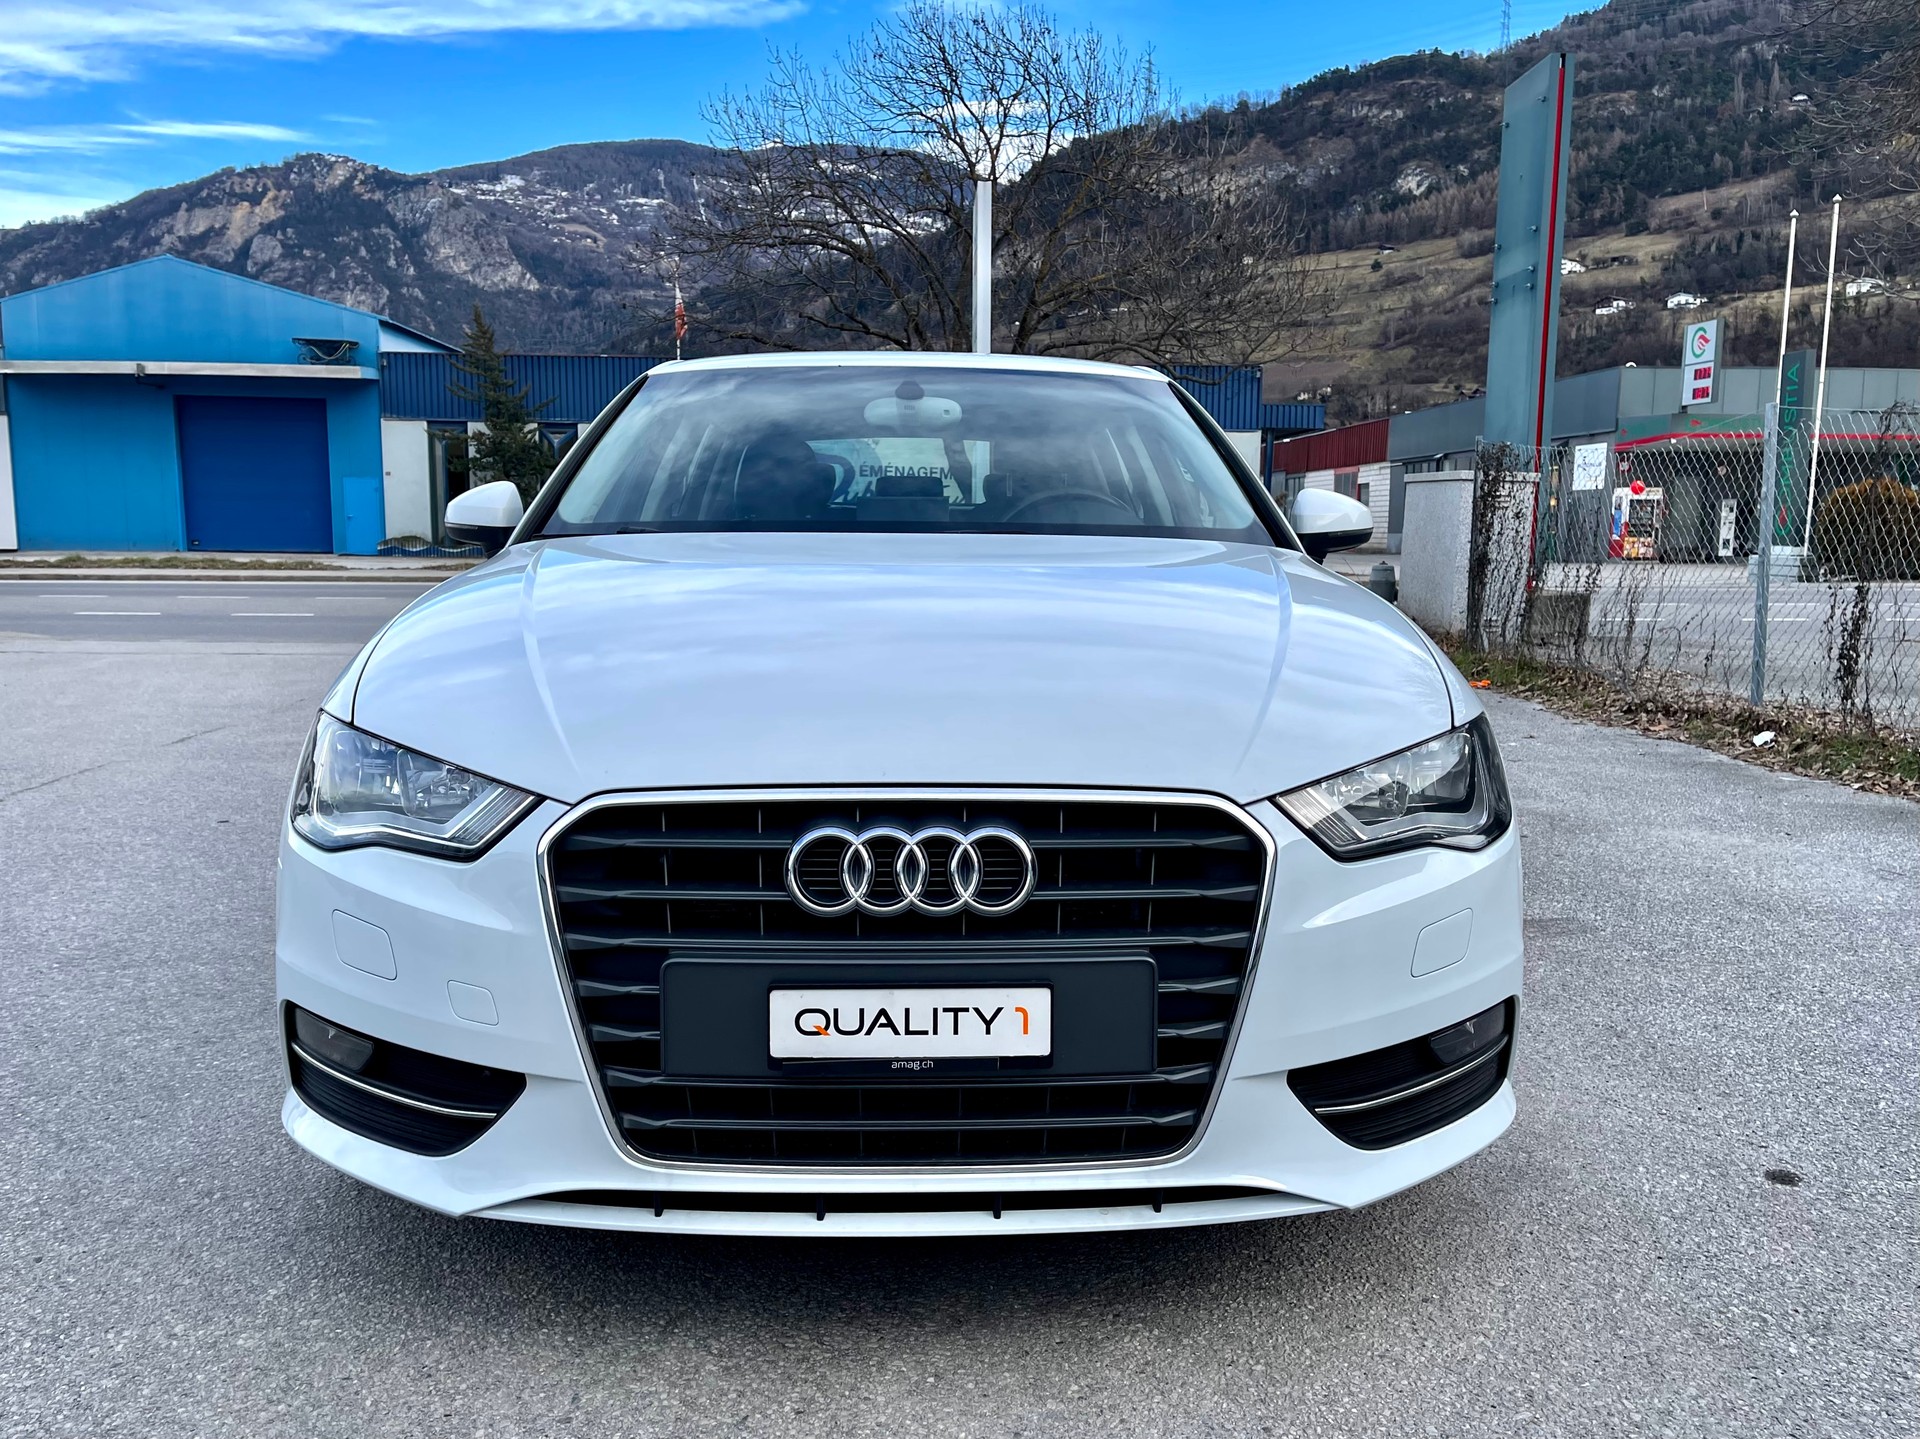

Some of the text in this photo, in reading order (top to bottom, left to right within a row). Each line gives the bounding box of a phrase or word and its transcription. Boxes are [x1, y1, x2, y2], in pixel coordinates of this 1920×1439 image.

[794, 1007, 1029, 1036] QUALITY 1
[891, 1060, 934, 1071] amag.ch
